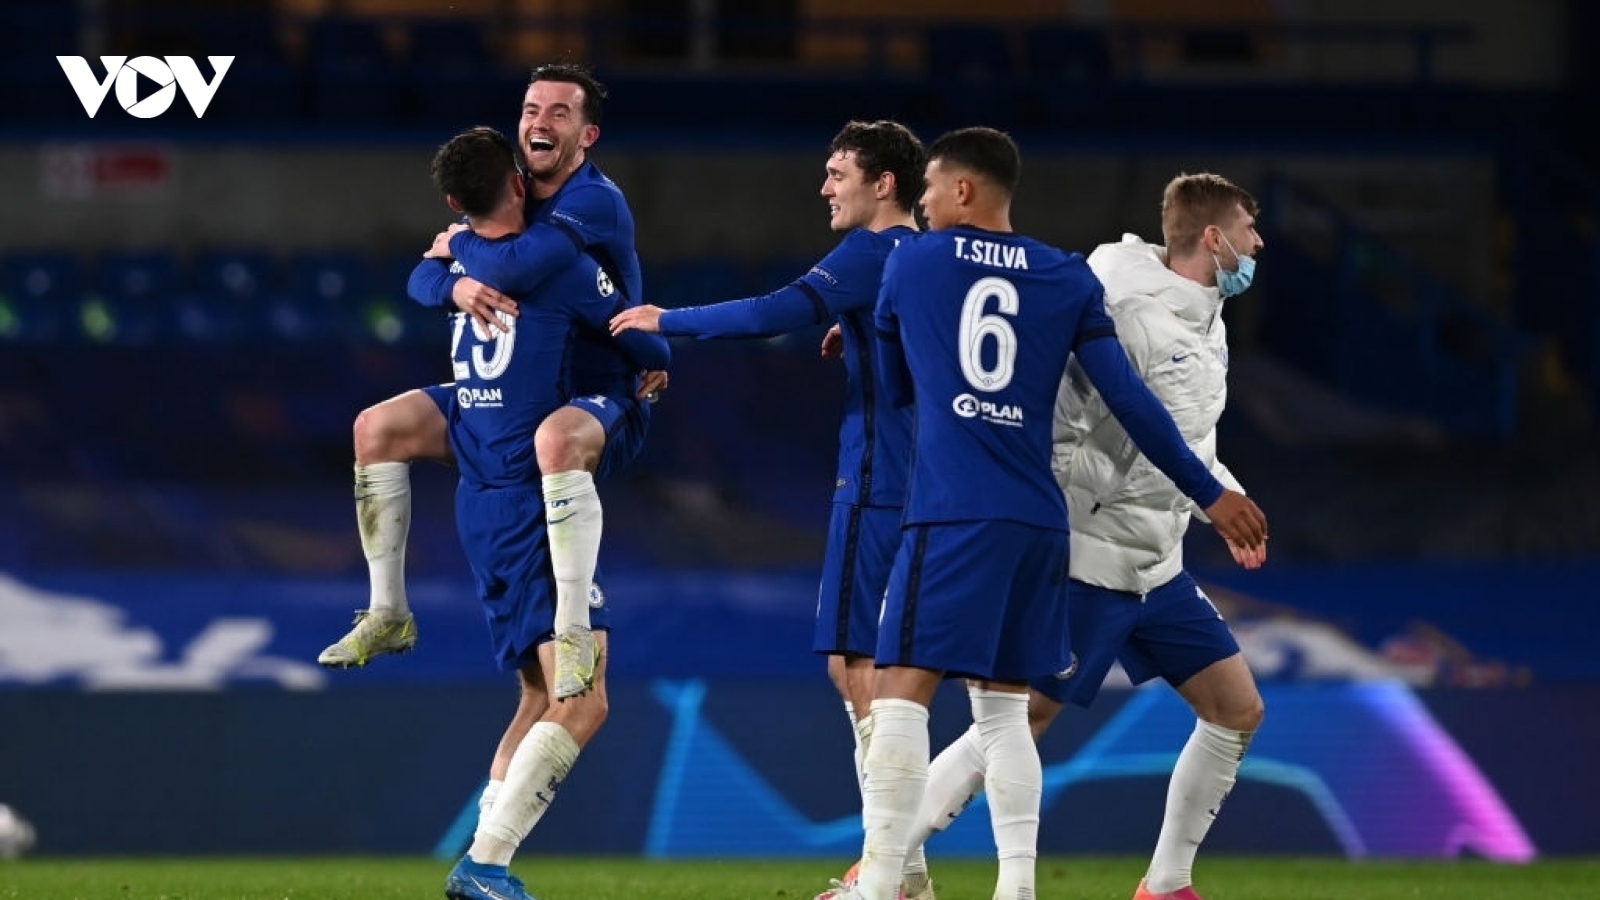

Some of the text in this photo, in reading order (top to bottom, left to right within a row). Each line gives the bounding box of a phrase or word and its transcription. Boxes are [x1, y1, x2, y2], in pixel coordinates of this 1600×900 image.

[954, 236, 1029, 270] T.SILVA
[958, 276, 1020, 393] 6
[471, 388, 503, 401] PLAN
[980, 401, 1023, 420] PLAN
